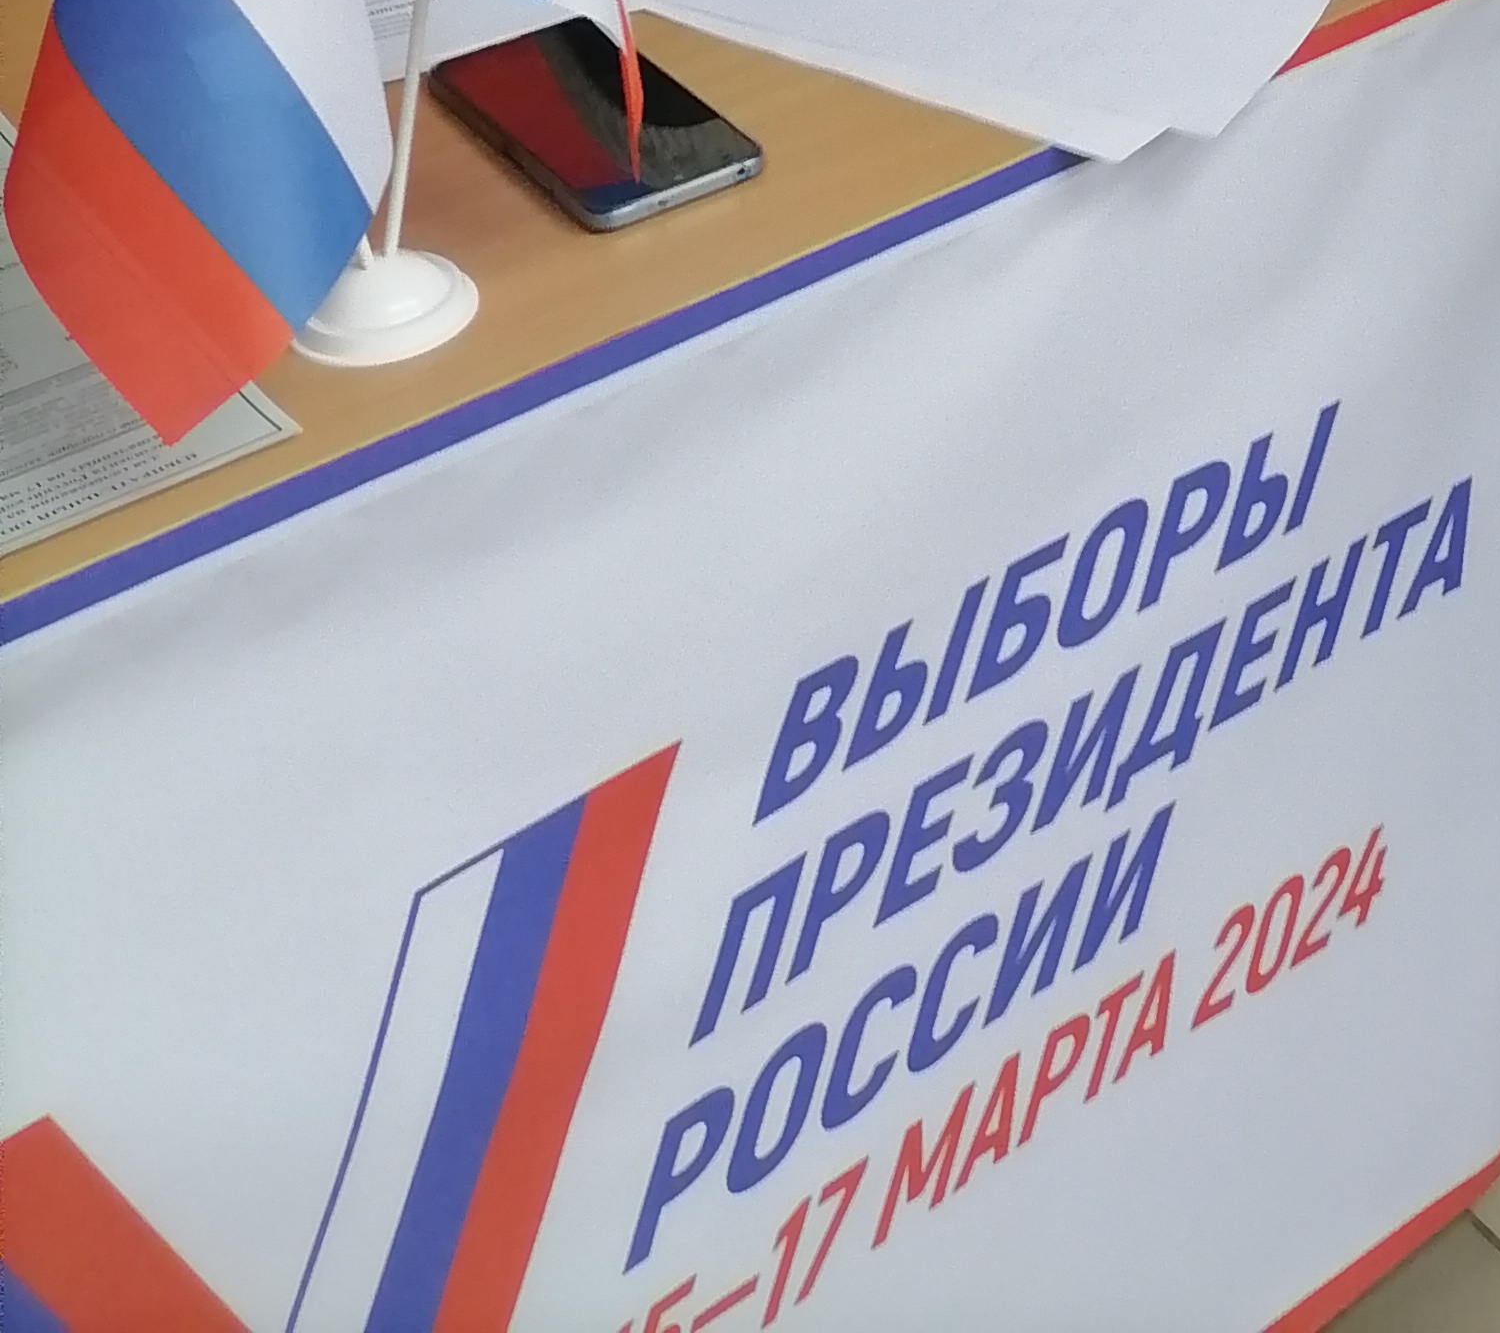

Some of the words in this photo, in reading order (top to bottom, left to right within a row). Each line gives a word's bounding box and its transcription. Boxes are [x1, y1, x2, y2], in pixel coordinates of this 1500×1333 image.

[690, 475, 1474, 1045] ПРЕЗИДЕНТА
[753, 401, 1340, 826] ВЫБОРЫ
[621, 801, 1177, 1275] РОССИИ
[870, 949, 1175, 1250] МАРТА
[1190, 823, 1387, 1031] 2024
